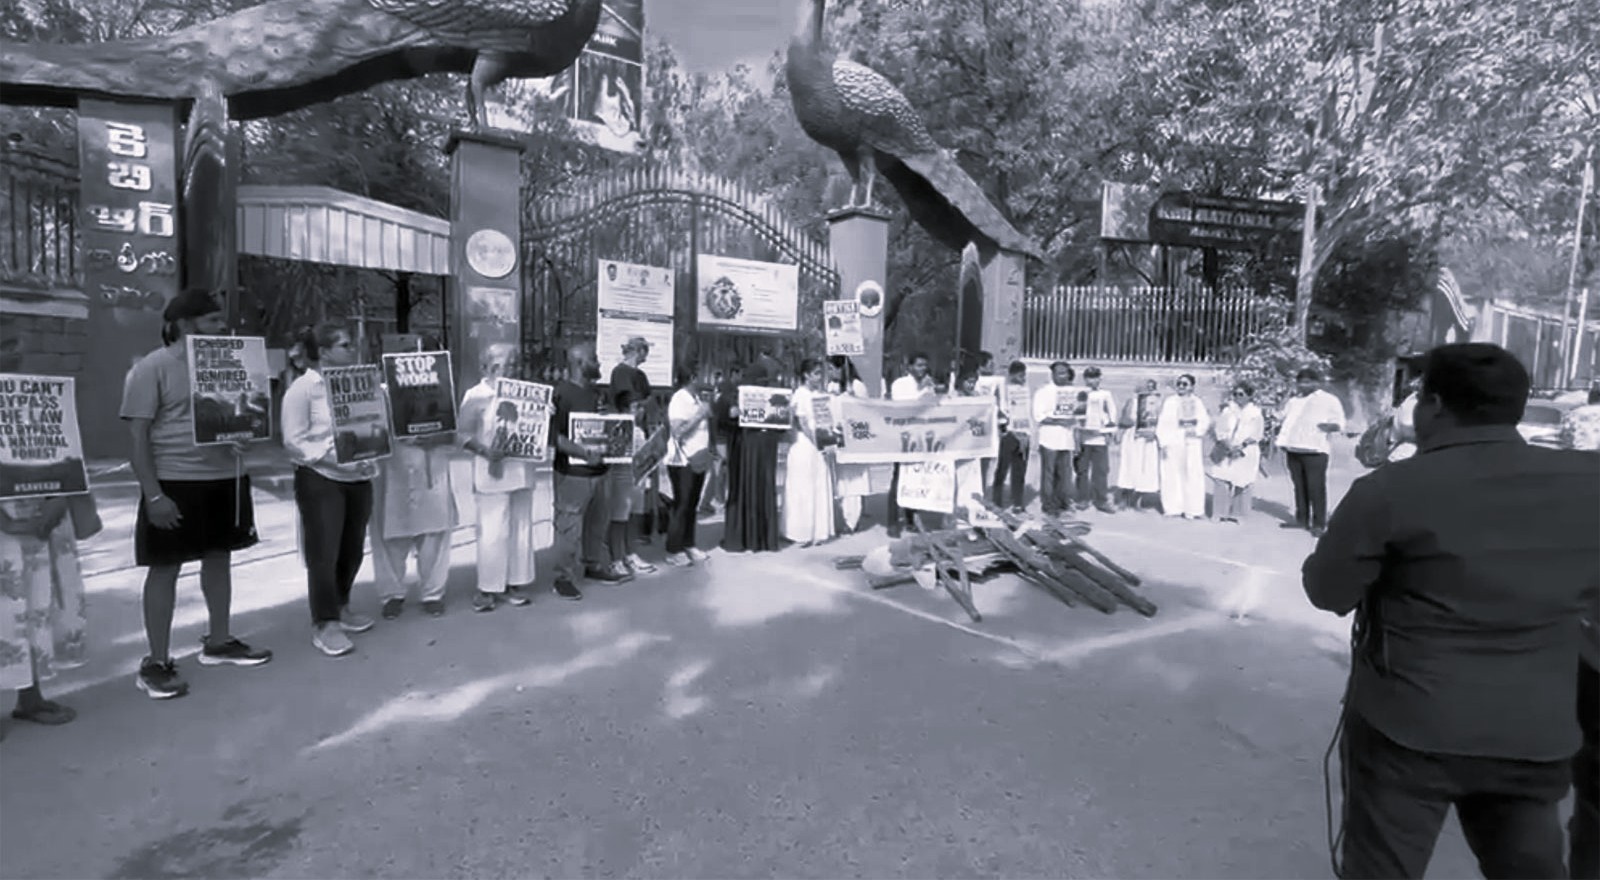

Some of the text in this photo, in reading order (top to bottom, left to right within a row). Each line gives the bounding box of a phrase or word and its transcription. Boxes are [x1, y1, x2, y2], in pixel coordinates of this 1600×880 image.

[395, 355, 436, 374] STOP
[330, 376, 351, 395] NO
[396, 371, 440, 387] WORK
[20, 381, 65, 396] CAN'T
[501, 381, 547, 402] NOTICE
[29, 409, 63, 424] LAW
[519, 422, 543, 435] CUT
